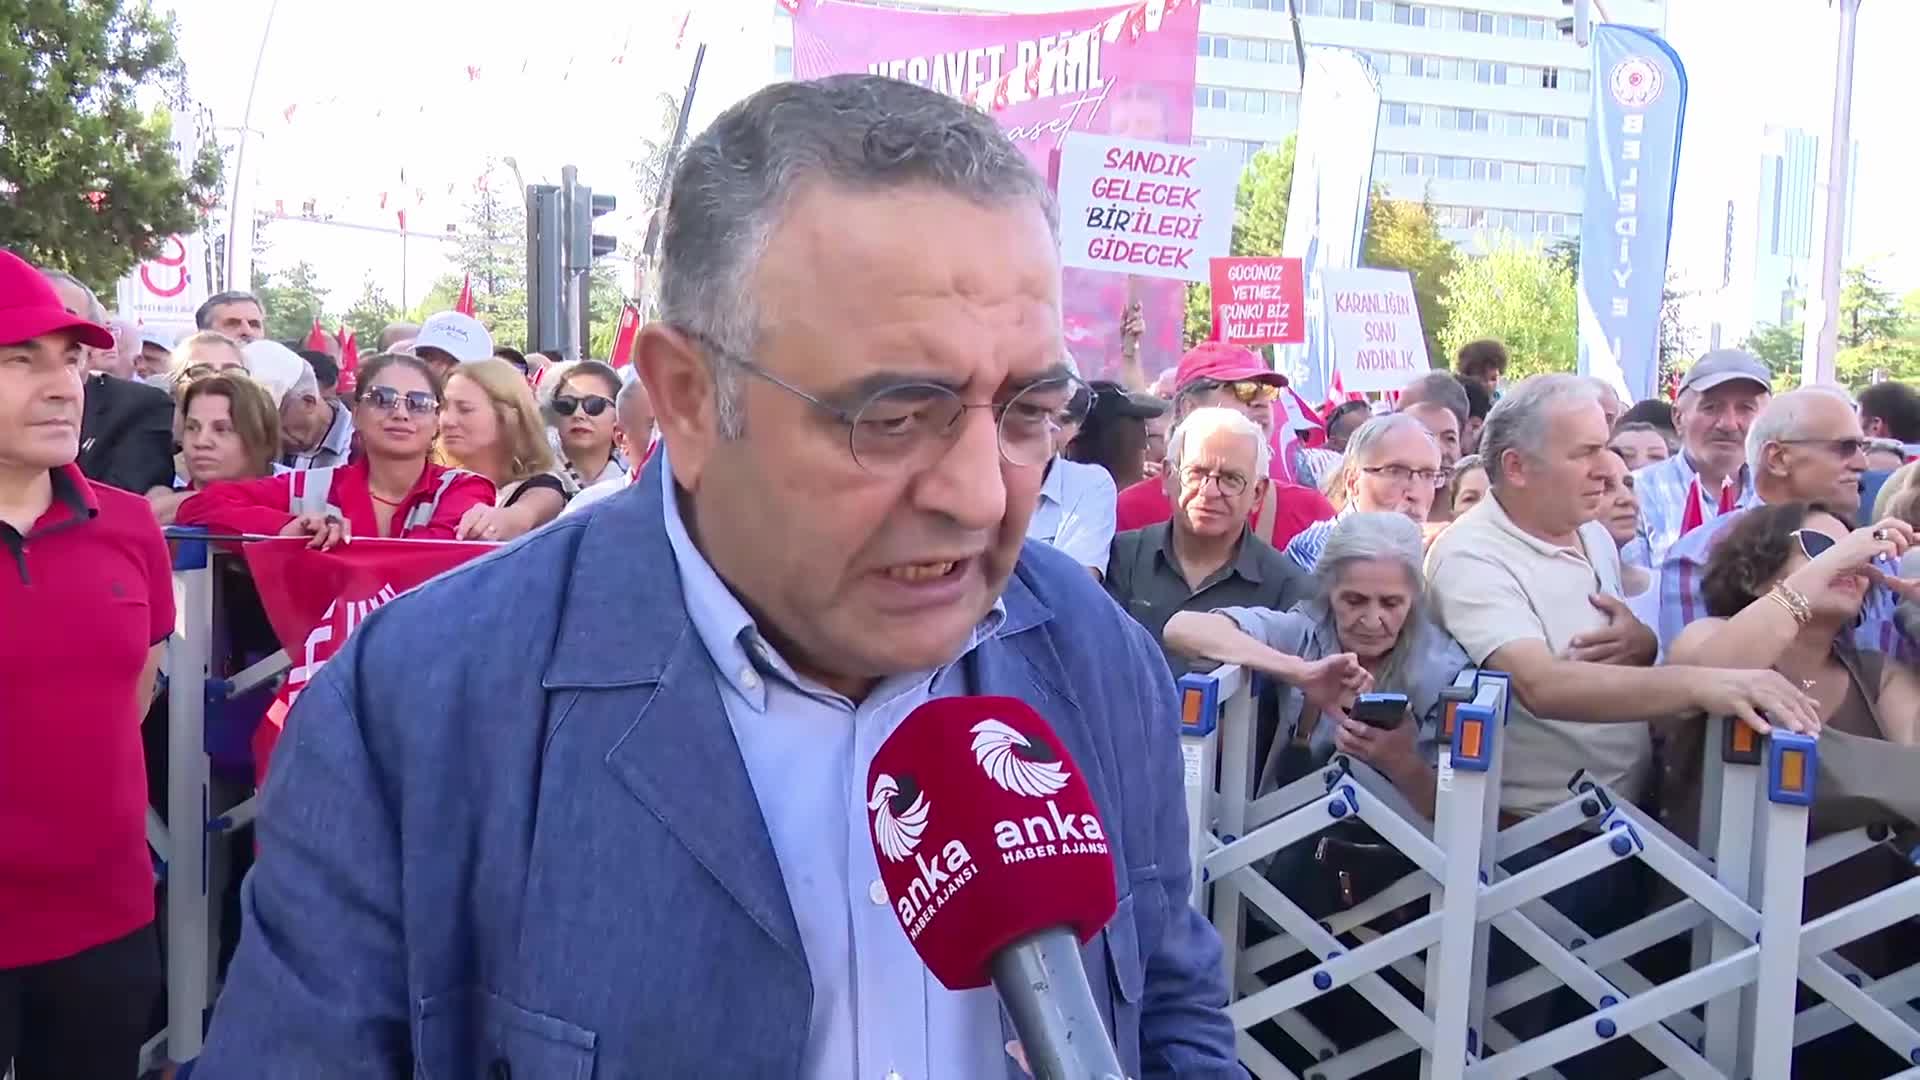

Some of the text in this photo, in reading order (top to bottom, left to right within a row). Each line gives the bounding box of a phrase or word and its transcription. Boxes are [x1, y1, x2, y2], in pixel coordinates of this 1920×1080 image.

[868, 44, 1008, 98] SAYET
[1103, 147, 1197, 179] SANDIK
[1091, 176, 1201, 209] GELECEK
[1087, 233, 1193, 269] GİDECEK
[1227, 263, 1284, 281] GÜCÜNÜZ
[1267, 301, 1290, 319] BİZ
[1335, 291, 1411, 315] KARANLIĞIN
[1364, 320, 1397, 343] SONU
[1356, 348, 1415, 371] AYDINLIK
[993, 800, 1105, 849] anka
[1001, 841, 1108, 865] HABER AJANSI
[897, 839, 972, 927] anka
[908, 862, 980, 941] HABER AJANSI
